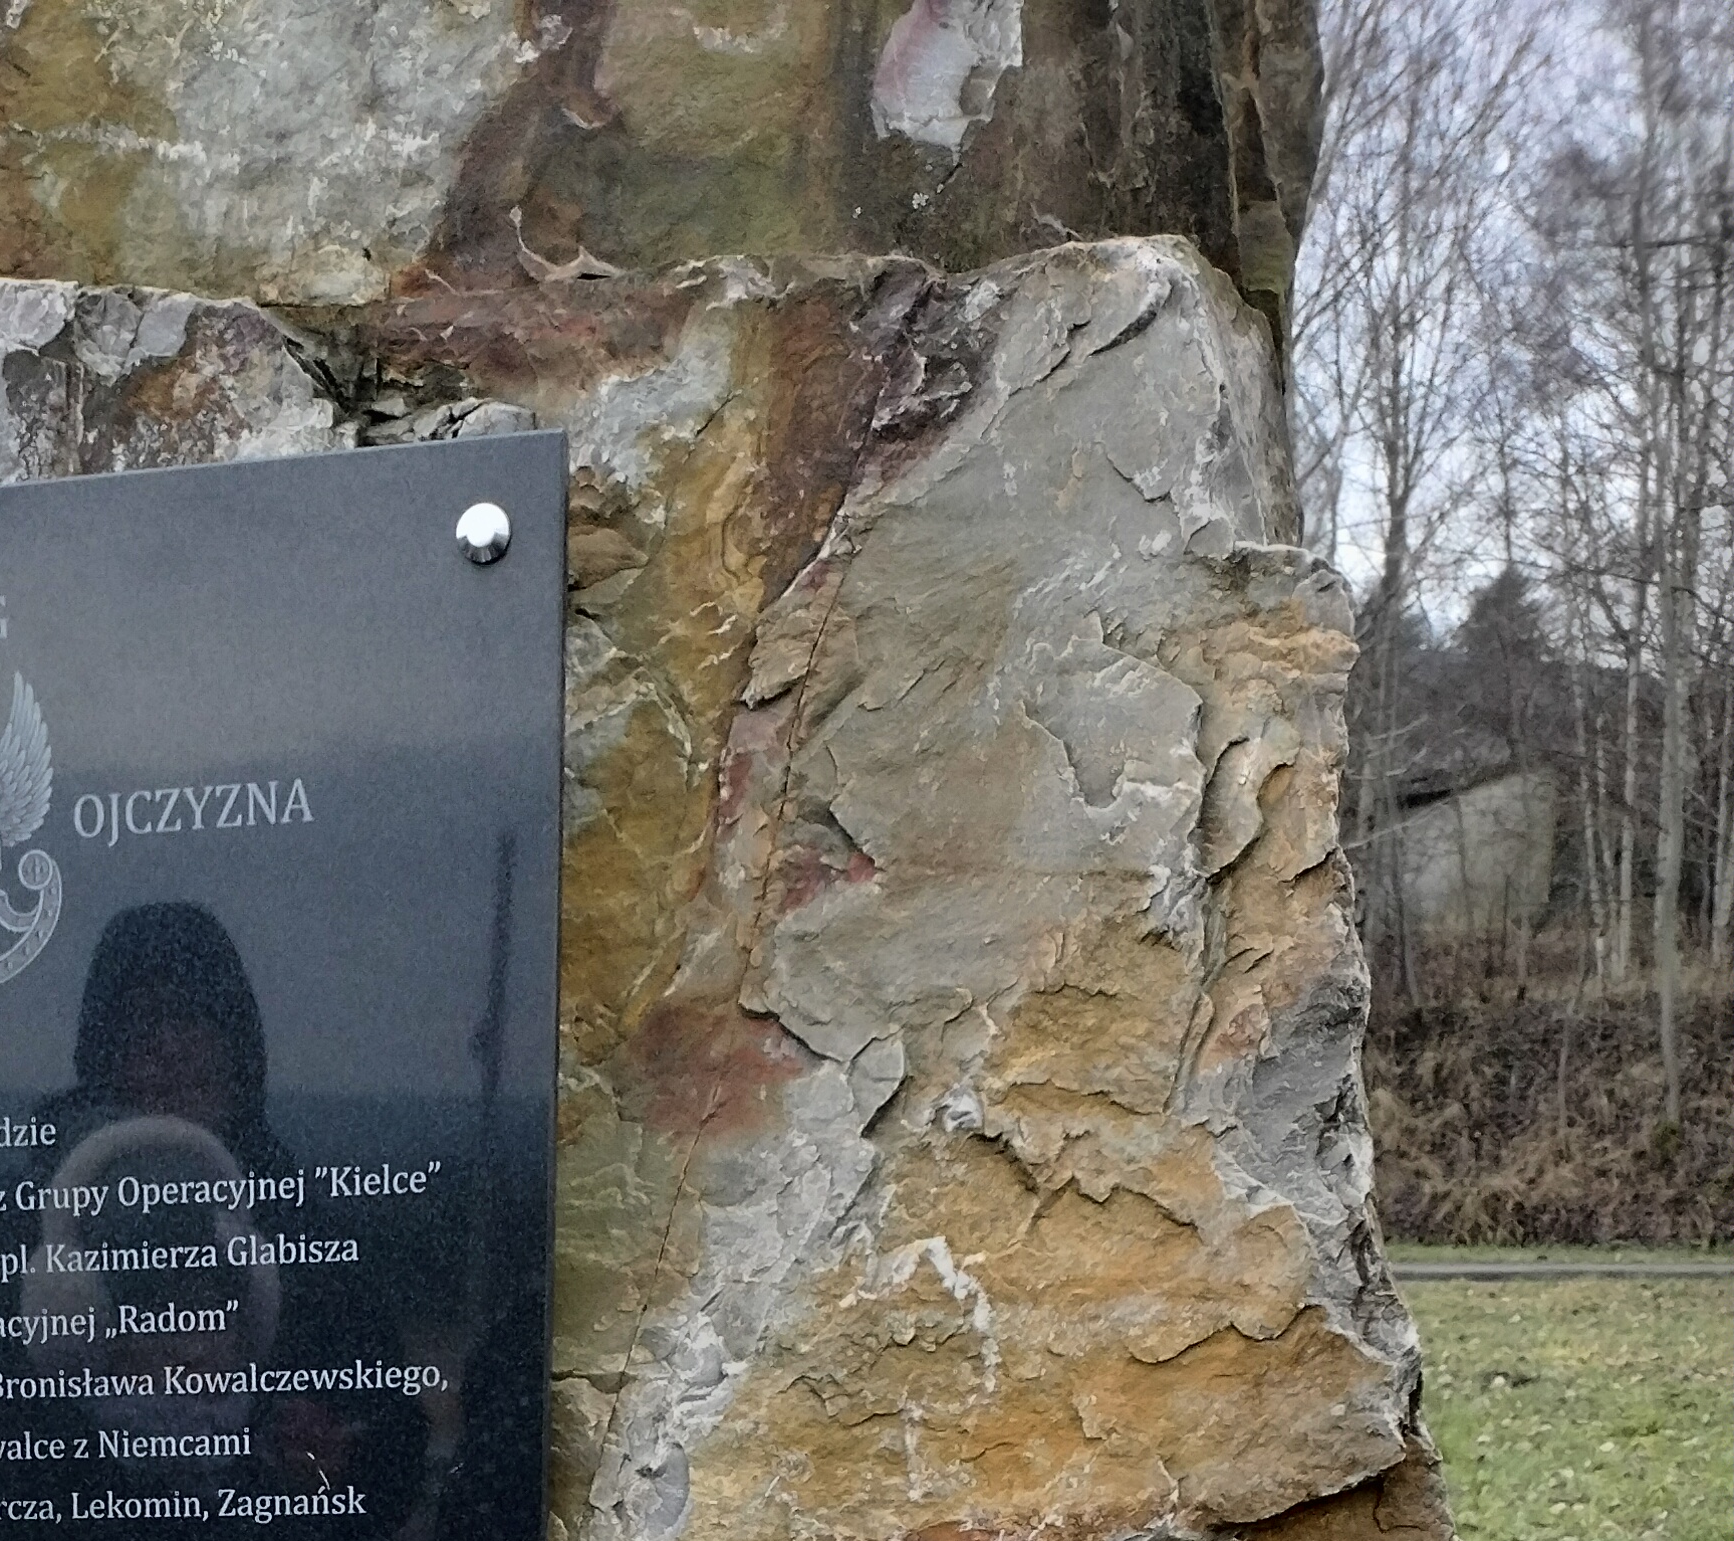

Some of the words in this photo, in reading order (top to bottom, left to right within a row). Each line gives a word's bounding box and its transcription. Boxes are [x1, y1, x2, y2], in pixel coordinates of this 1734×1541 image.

[73, 778, 314, 848] OJCZYZNA
[15, 1180, 109, 1217] Grupy
[117, 1169, 304, 1214] Operacyjnej
[45, 1240, 218, 1274] Kazimierza
[227, 1233, 359, 1266] Glabisza
[163, 1359, 448, 1396] Kowalczewskiego,
[73, 1438, 89, 1459] z
[98, 1427, 251, 1458] Niemcami
[71, 1490, 209, 1522] Lekomin,
[217, 1484, 366, 1524] Zagnańsk
